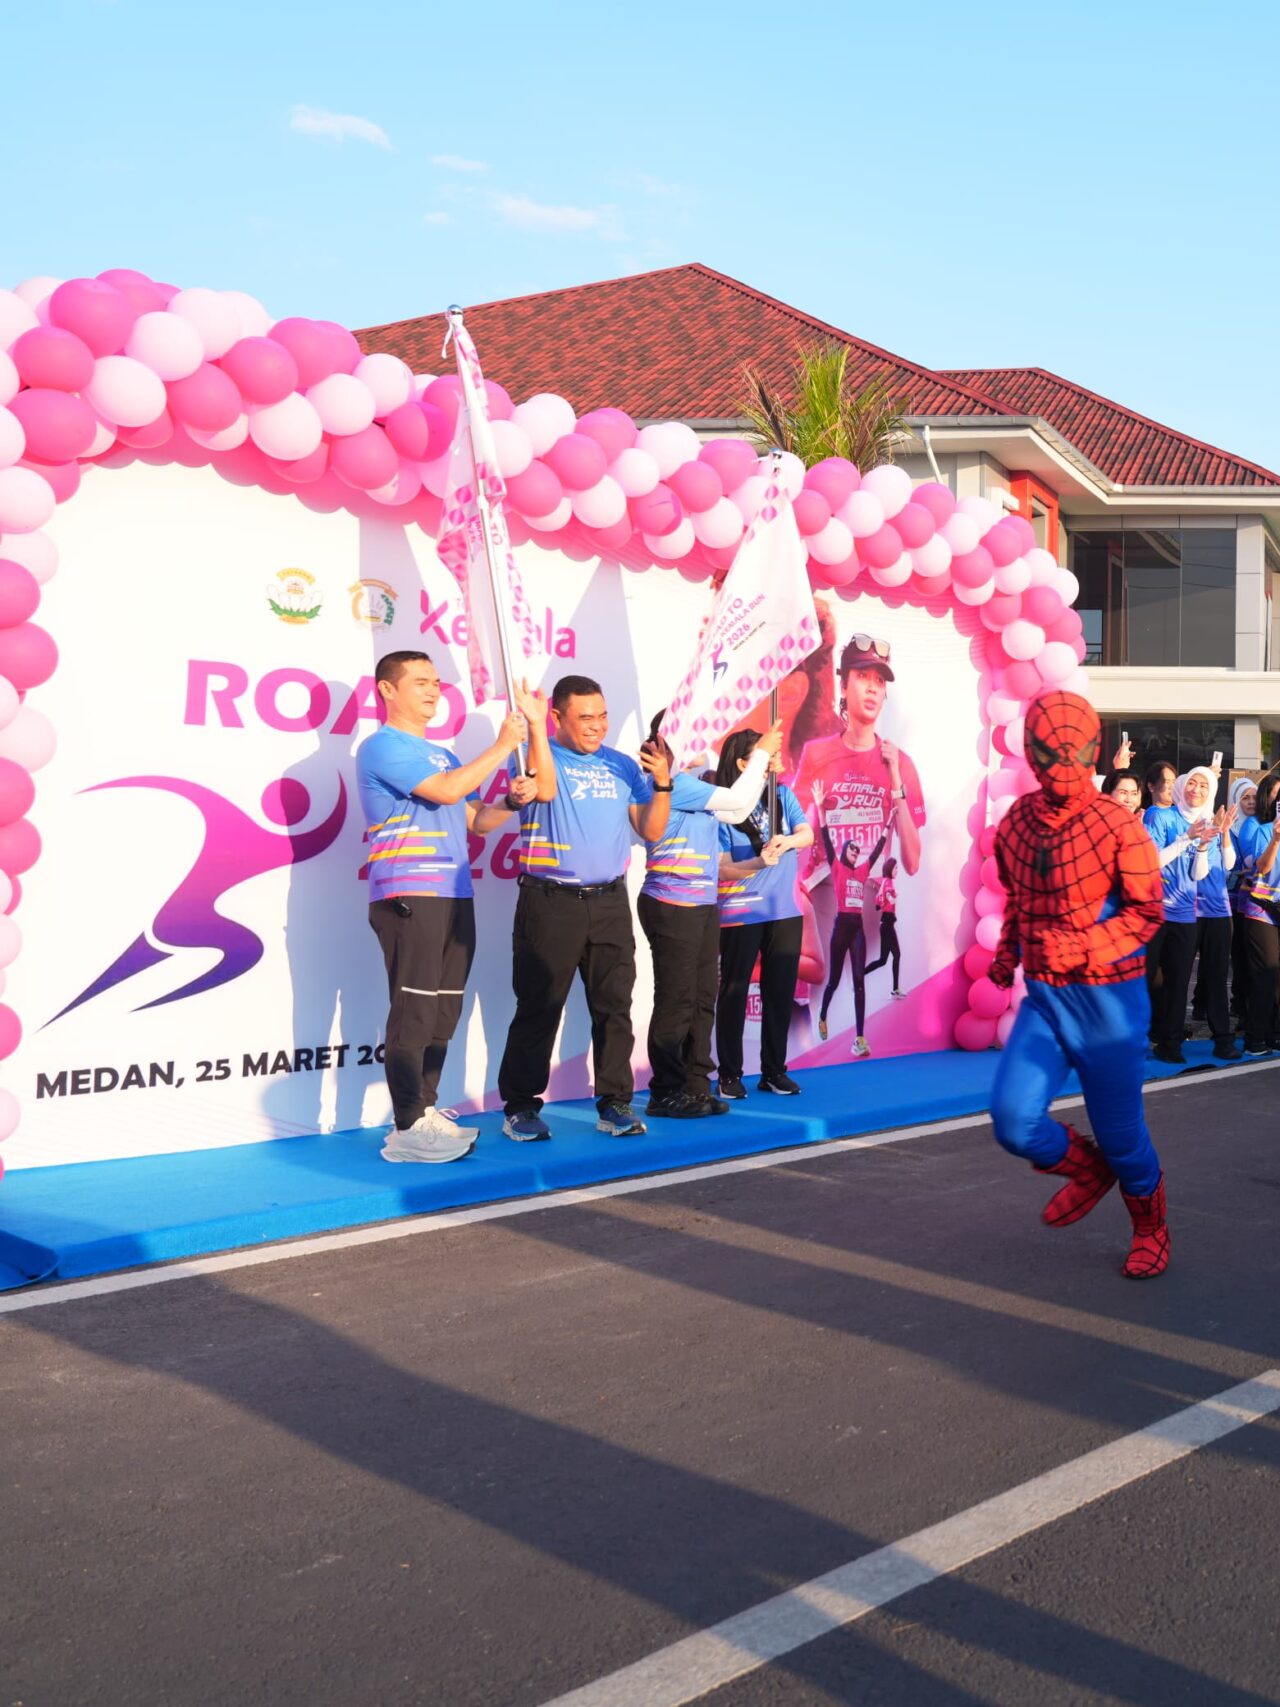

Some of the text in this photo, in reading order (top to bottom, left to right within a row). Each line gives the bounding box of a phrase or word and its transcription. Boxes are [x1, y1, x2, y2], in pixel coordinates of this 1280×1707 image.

[420, 589, 577, 658] Kela
[727, 623, 750, 646] 2026
[831, 782, 886, 797] KEMALA
[853, 795, 883, 807] RUN
[748, 995, 762, 1014] 15
[36, 1044, 387, 1099] MEDAN, 25 MARET 20
